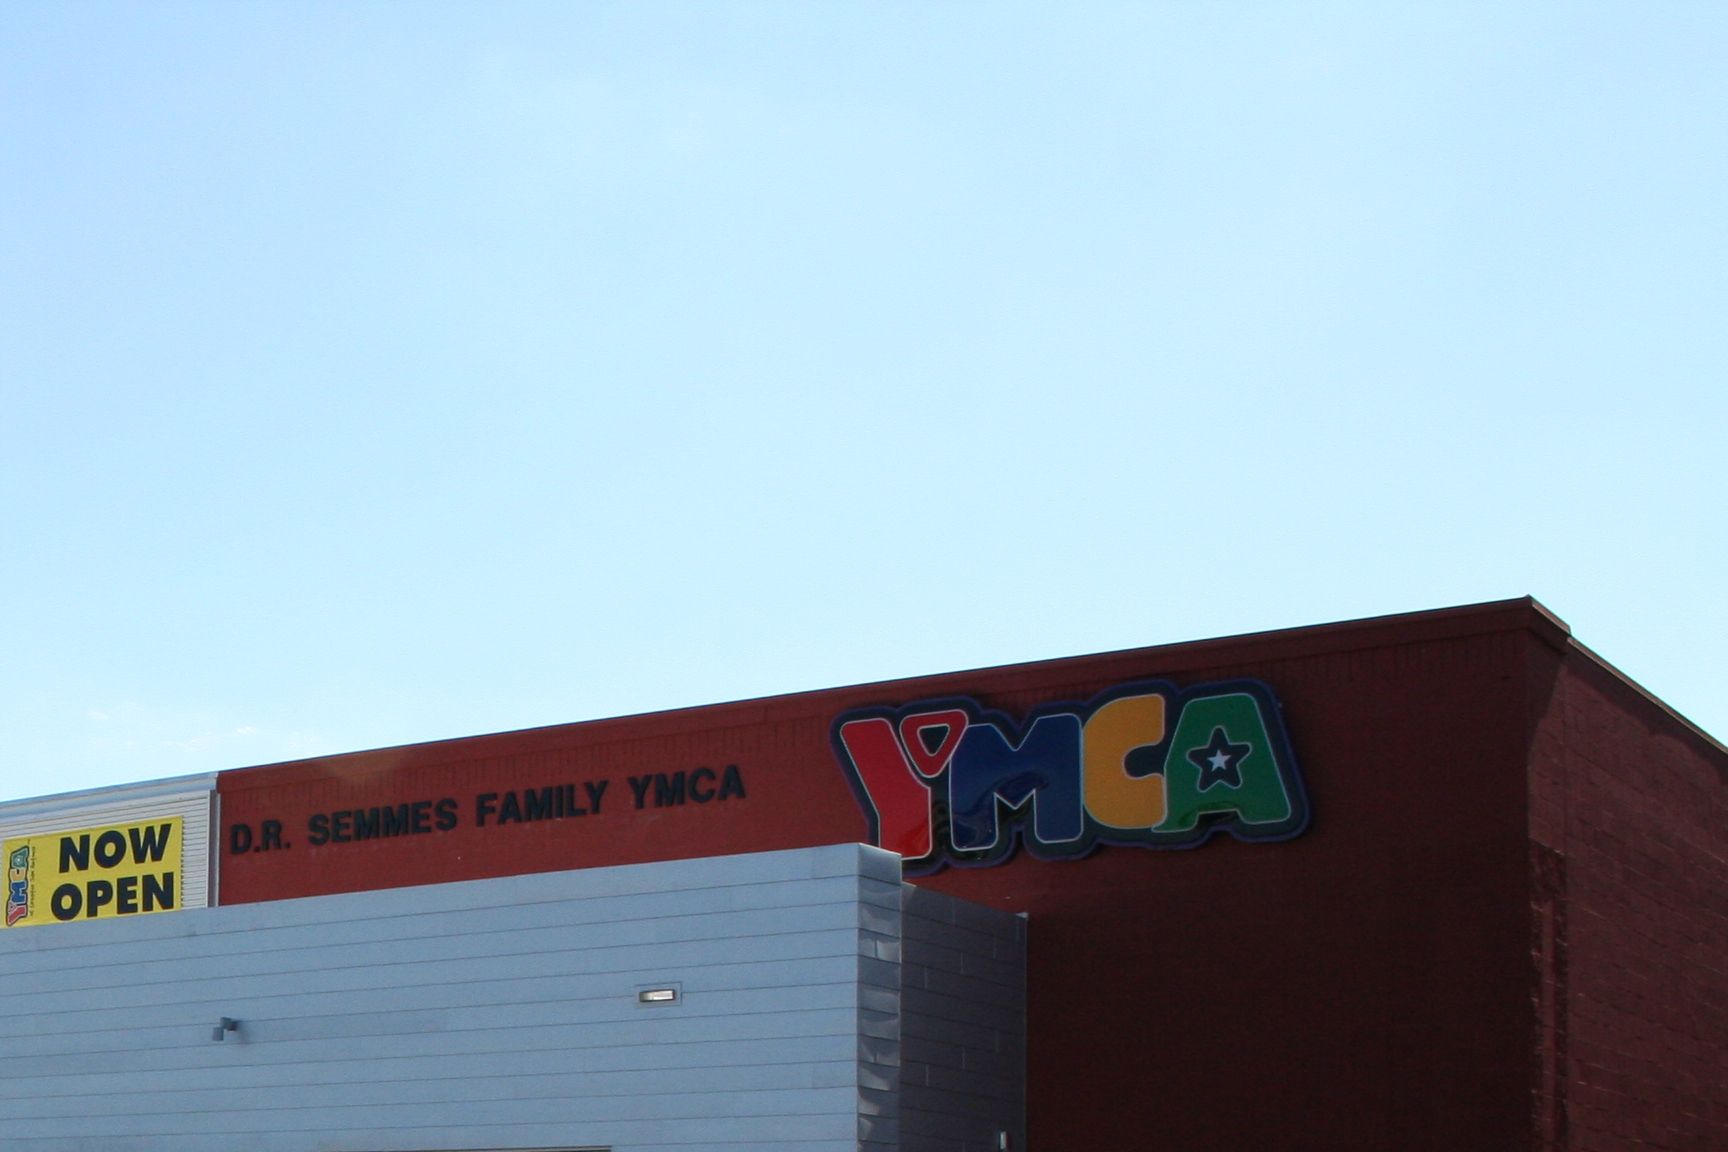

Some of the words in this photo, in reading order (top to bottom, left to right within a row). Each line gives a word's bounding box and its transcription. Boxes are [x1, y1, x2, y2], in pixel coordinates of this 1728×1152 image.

[229, 819, 291, 855] D.R.
[307, 797, 459, 847] SEMMES
[475, 779, 610, 828] FAMILY
[627, 763, 747, 811] YMCA
[839, 692, 1292, 860] YMCA
[5, 845, 30, 927] YMCA
[58, 823, 173, 874] NOW
[50, 871, 175, 922] OPEN
